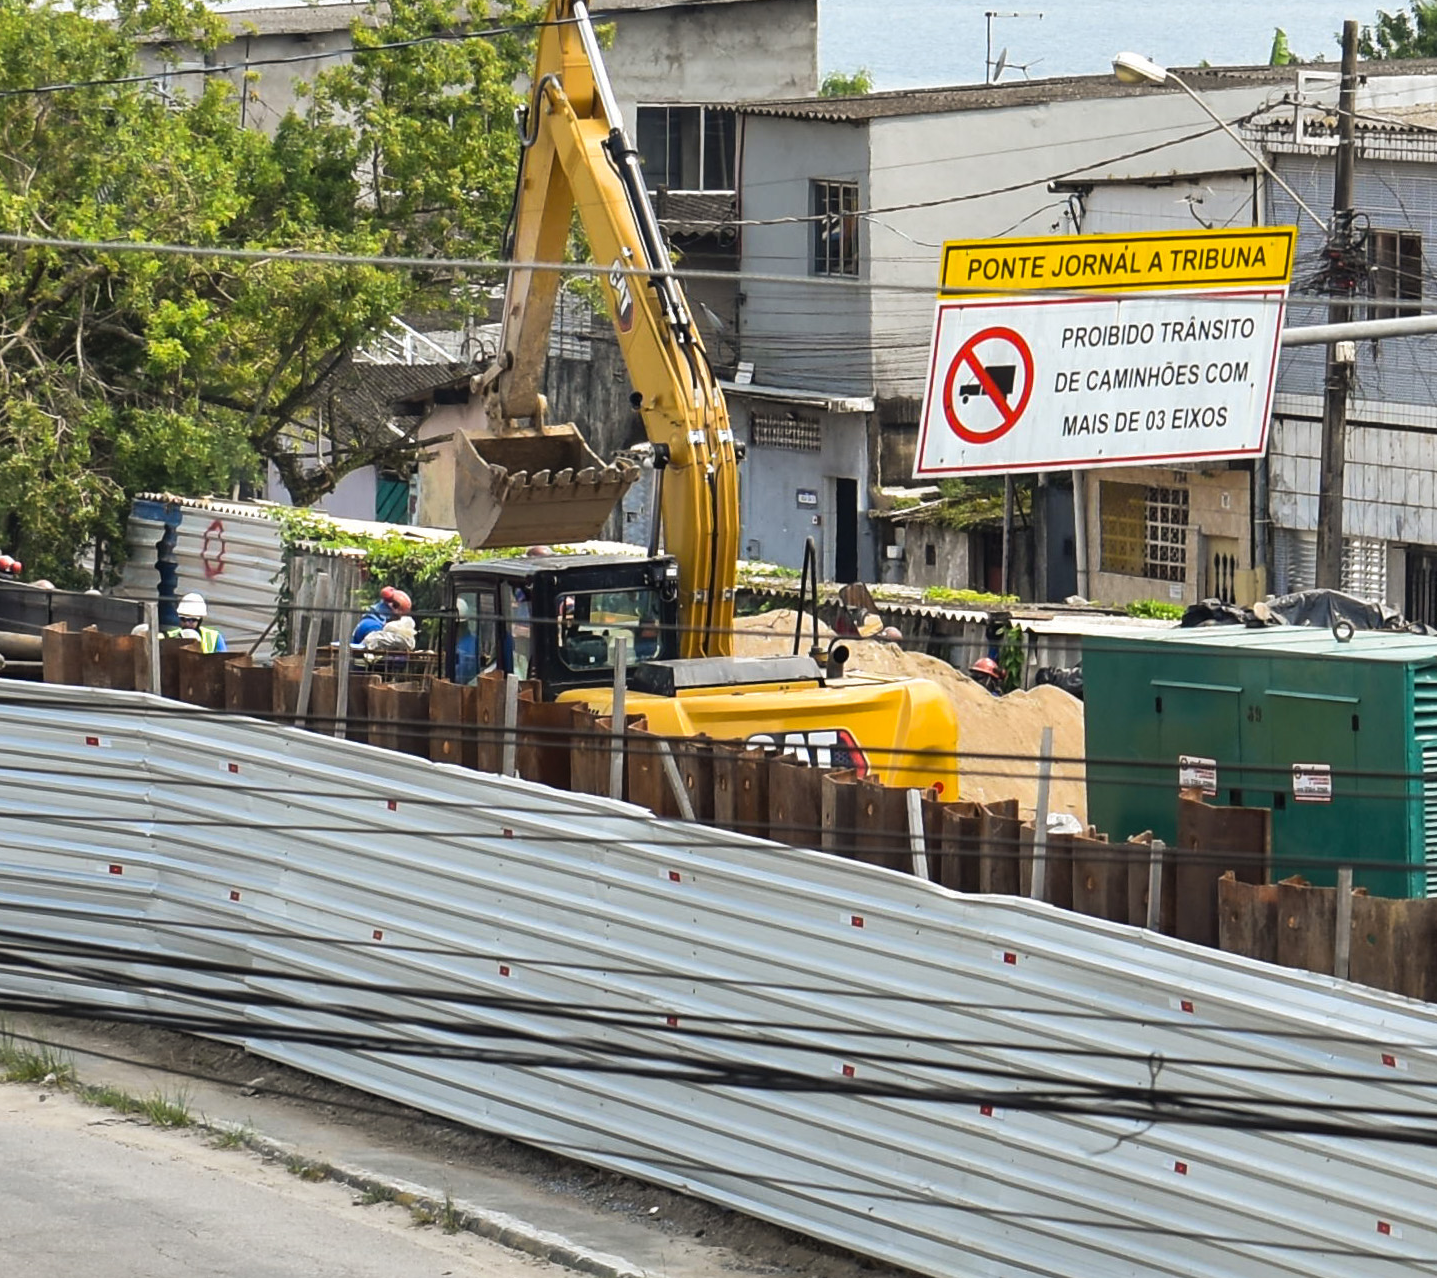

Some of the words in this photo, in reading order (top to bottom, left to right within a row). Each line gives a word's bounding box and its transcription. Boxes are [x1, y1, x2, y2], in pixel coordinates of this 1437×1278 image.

[967, 255, 1045, 281] PONTE
[1051, 249, 1141, 278] JORNAL
[1147, 250, 1164, 272] A
[1170, 245, 1267, 272] TRIBUNA
[609, 259, 632, 316] CAT
[1061, 323, 1155, 349] PROIBIDO
[1160, 315, 1256, 345] TRÂNSITO
[1054, 370, 1081, 394] DE
[1085, 361, 1200, 393] CAMINHÕES
[1204, 361, 1250, 384] COM
[1062, 413, 1110, 437] MAIS
[1114, 411, 1140, 434] DE
[1145, 409, 1167, 432] 03
[1171, 405, 1229, 430] EIXOS
